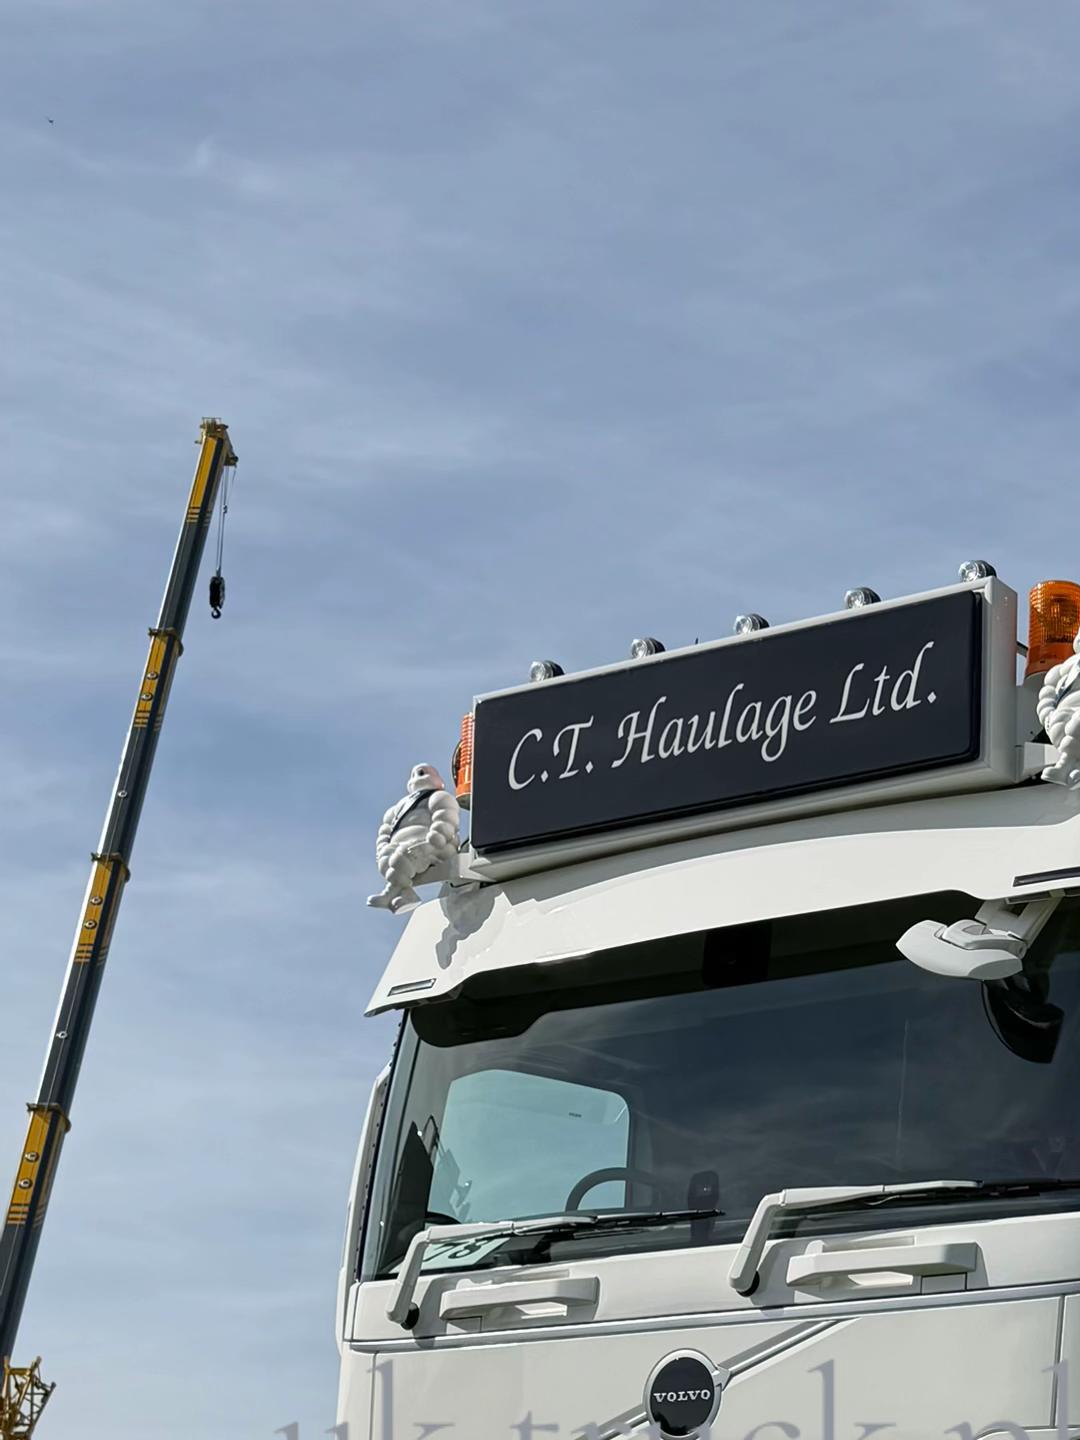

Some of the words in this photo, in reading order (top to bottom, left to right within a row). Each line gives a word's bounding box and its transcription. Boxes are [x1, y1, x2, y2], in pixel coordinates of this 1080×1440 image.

[507, 714, 594, 791] C.T.
[611, 682, 817, 769] Haulage
[828, 641, 938, 725] Ltd.
[653, 1388, 711, 1402] VOLVO
